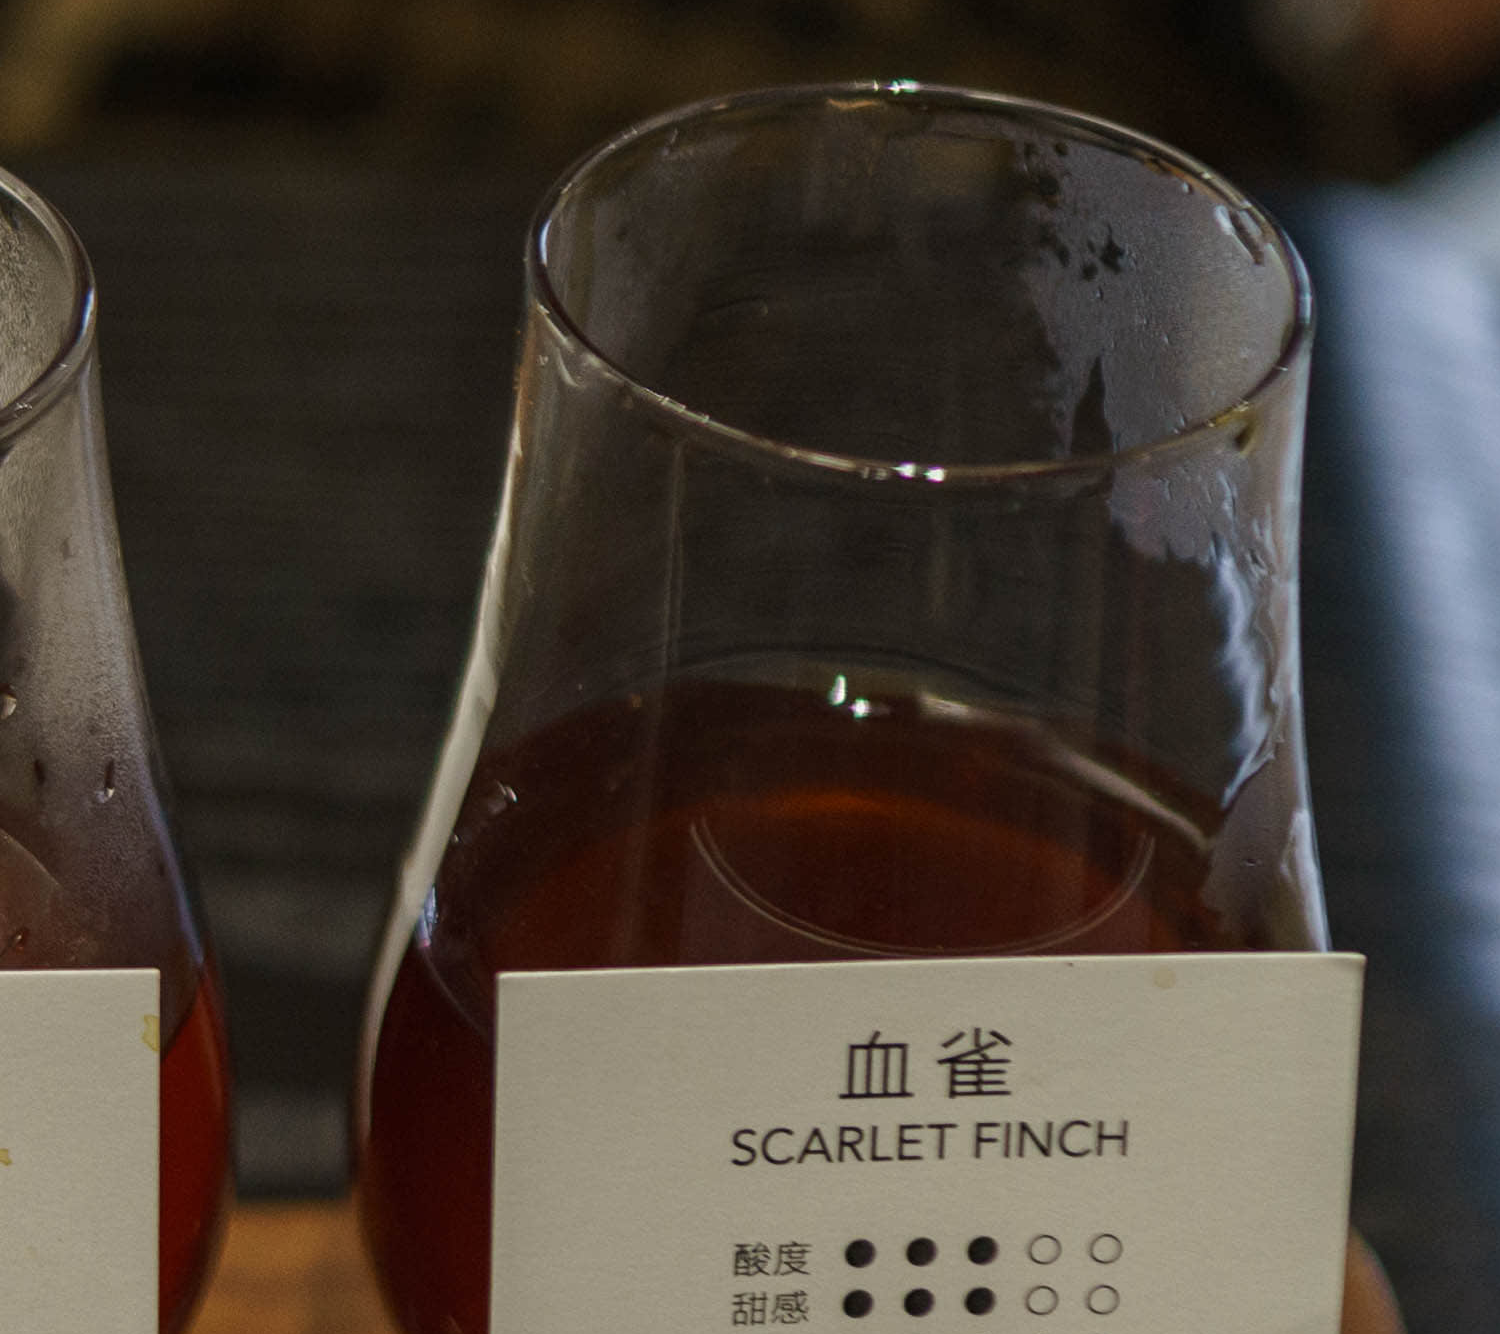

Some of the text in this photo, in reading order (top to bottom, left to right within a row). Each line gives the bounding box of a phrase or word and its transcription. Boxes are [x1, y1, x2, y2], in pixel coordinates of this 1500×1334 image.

[838, 1027, 1012, 1101] 血雀
[731, 1119, 1129, 1168] SCARLET FINCH
[732, 1240, 809, 1278] 酸度
[731, 1289, 809, 1327] 甜感
